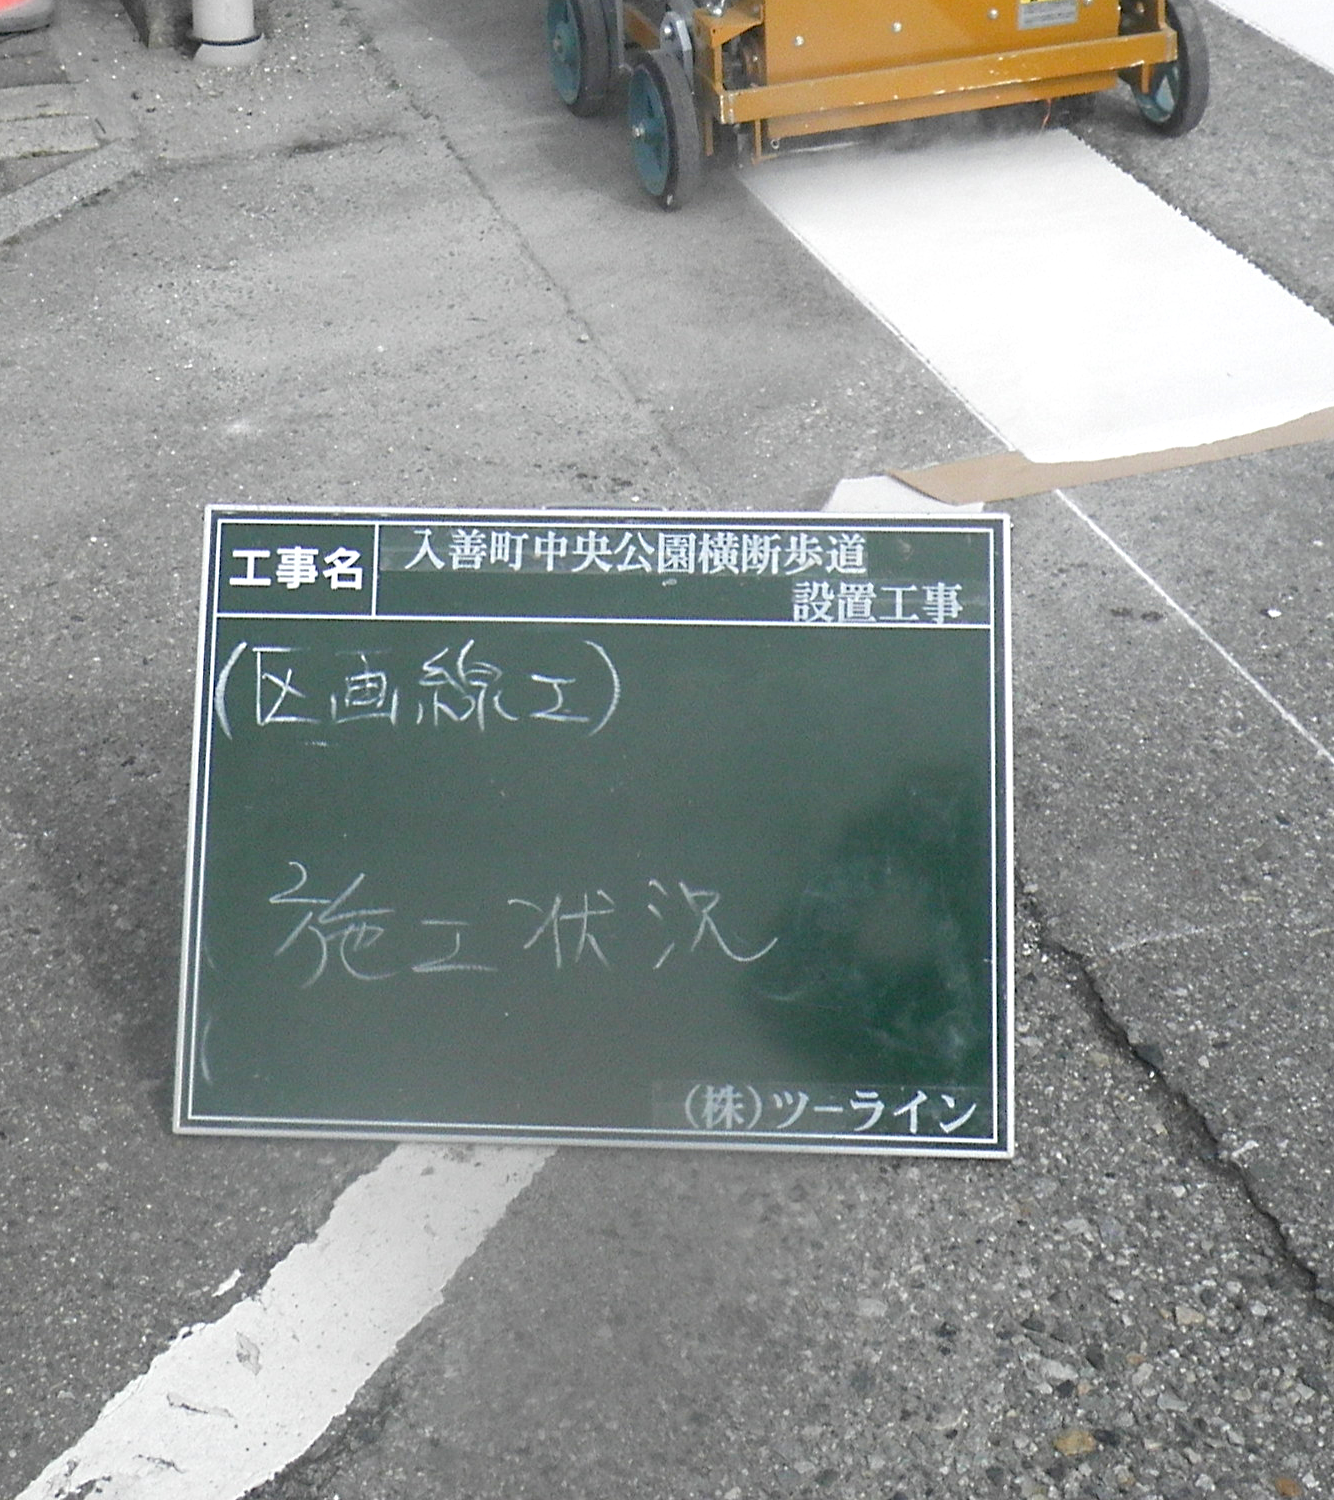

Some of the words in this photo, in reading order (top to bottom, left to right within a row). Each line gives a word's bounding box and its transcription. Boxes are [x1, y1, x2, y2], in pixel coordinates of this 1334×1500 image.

[229, 546, 363, 591] 工事名
[404, 528, 867, 576] 入善町中央公園横断歩道
[792, 580, 964, 625] 設置工事
[268, 861, 779, 989] 施工状況
